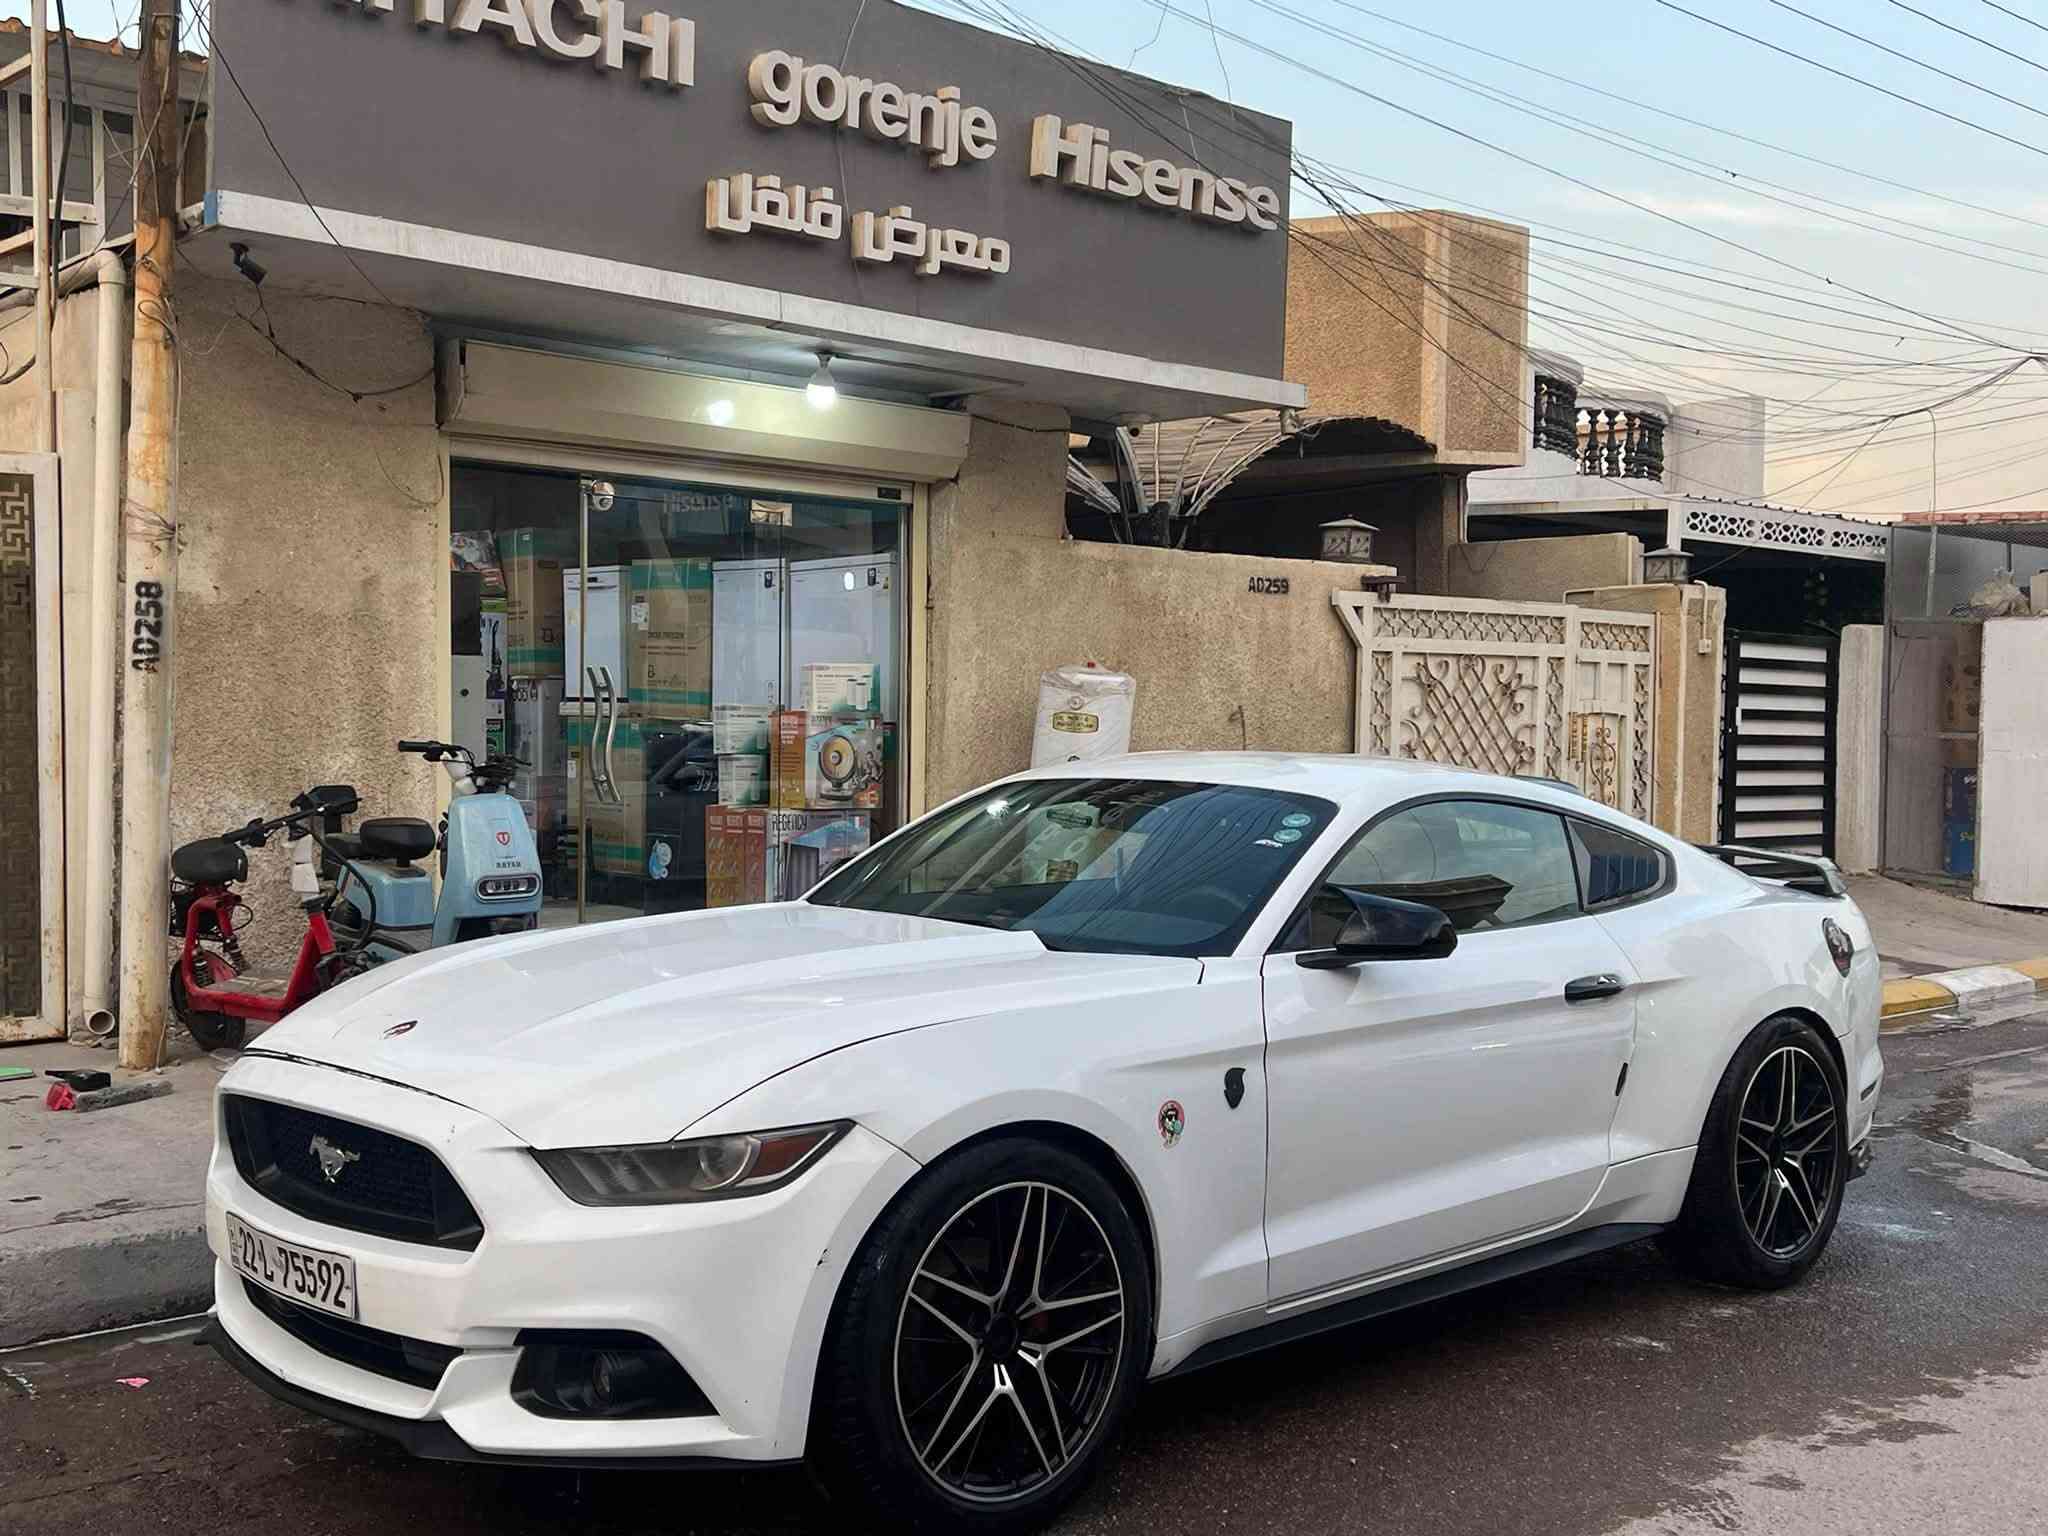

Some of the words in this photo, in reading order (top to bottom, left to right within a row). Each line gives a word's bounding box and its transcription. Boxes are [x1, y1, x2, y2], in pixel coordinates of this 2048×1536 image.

[352, 0, 696, 89] ACHI
[748, 49, 998, 167] gorenje
[705, 172, 843, 240] فلفل
[1029, 113, 1281, 232] Hisense
[852, 205, 1010, 275] معرض
[131, 581, 163, 673] AD258
[1247, 576, 1289, 595] AD259
